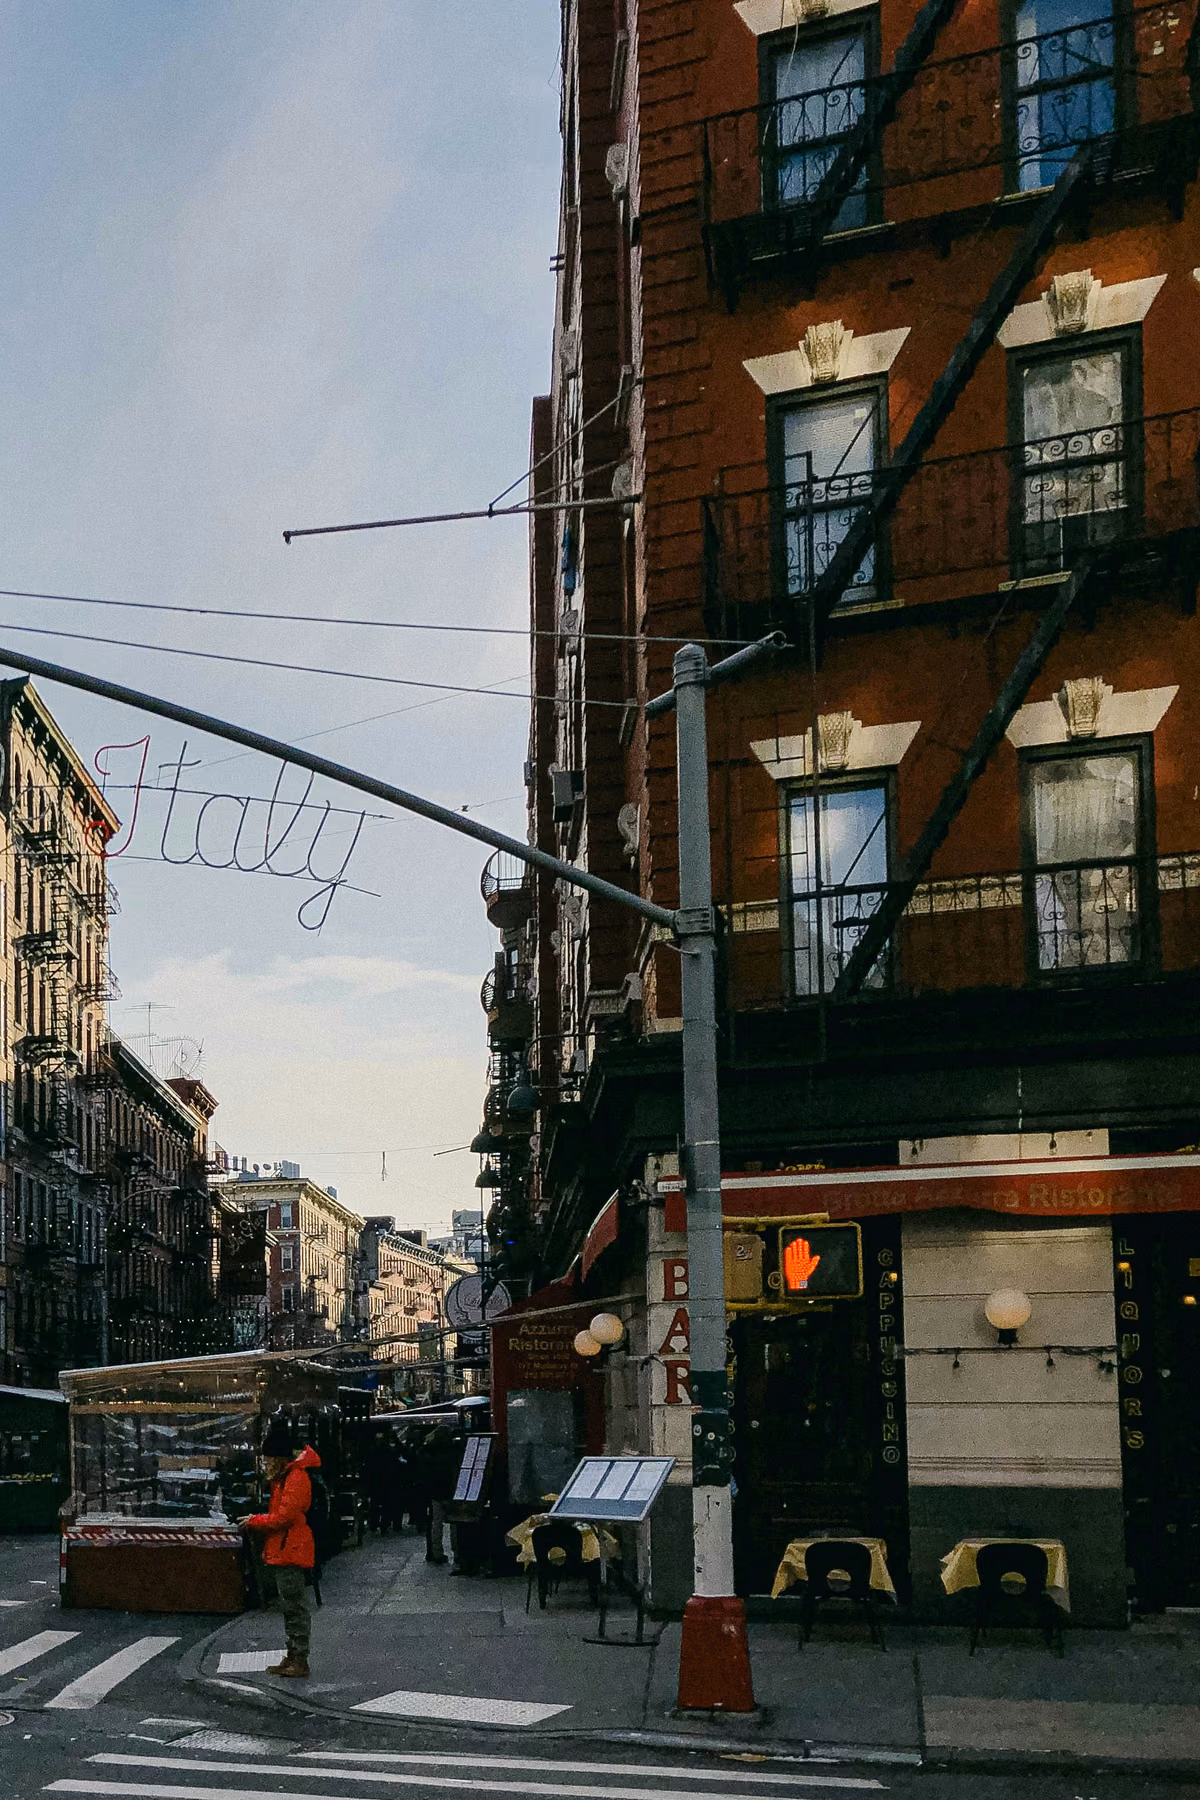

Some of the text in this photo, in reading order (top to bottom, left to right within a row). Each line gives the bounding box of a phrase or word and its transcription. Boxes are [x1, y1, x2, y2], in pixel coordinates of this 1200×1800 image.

[86, 736, 366, 930] Italy
[659, 1258, 691, 1404] BAR
[877, 1248, 900, 1464] CAPPUCCINO
[1119, 1237, 1144, 1449] LIQUORS
